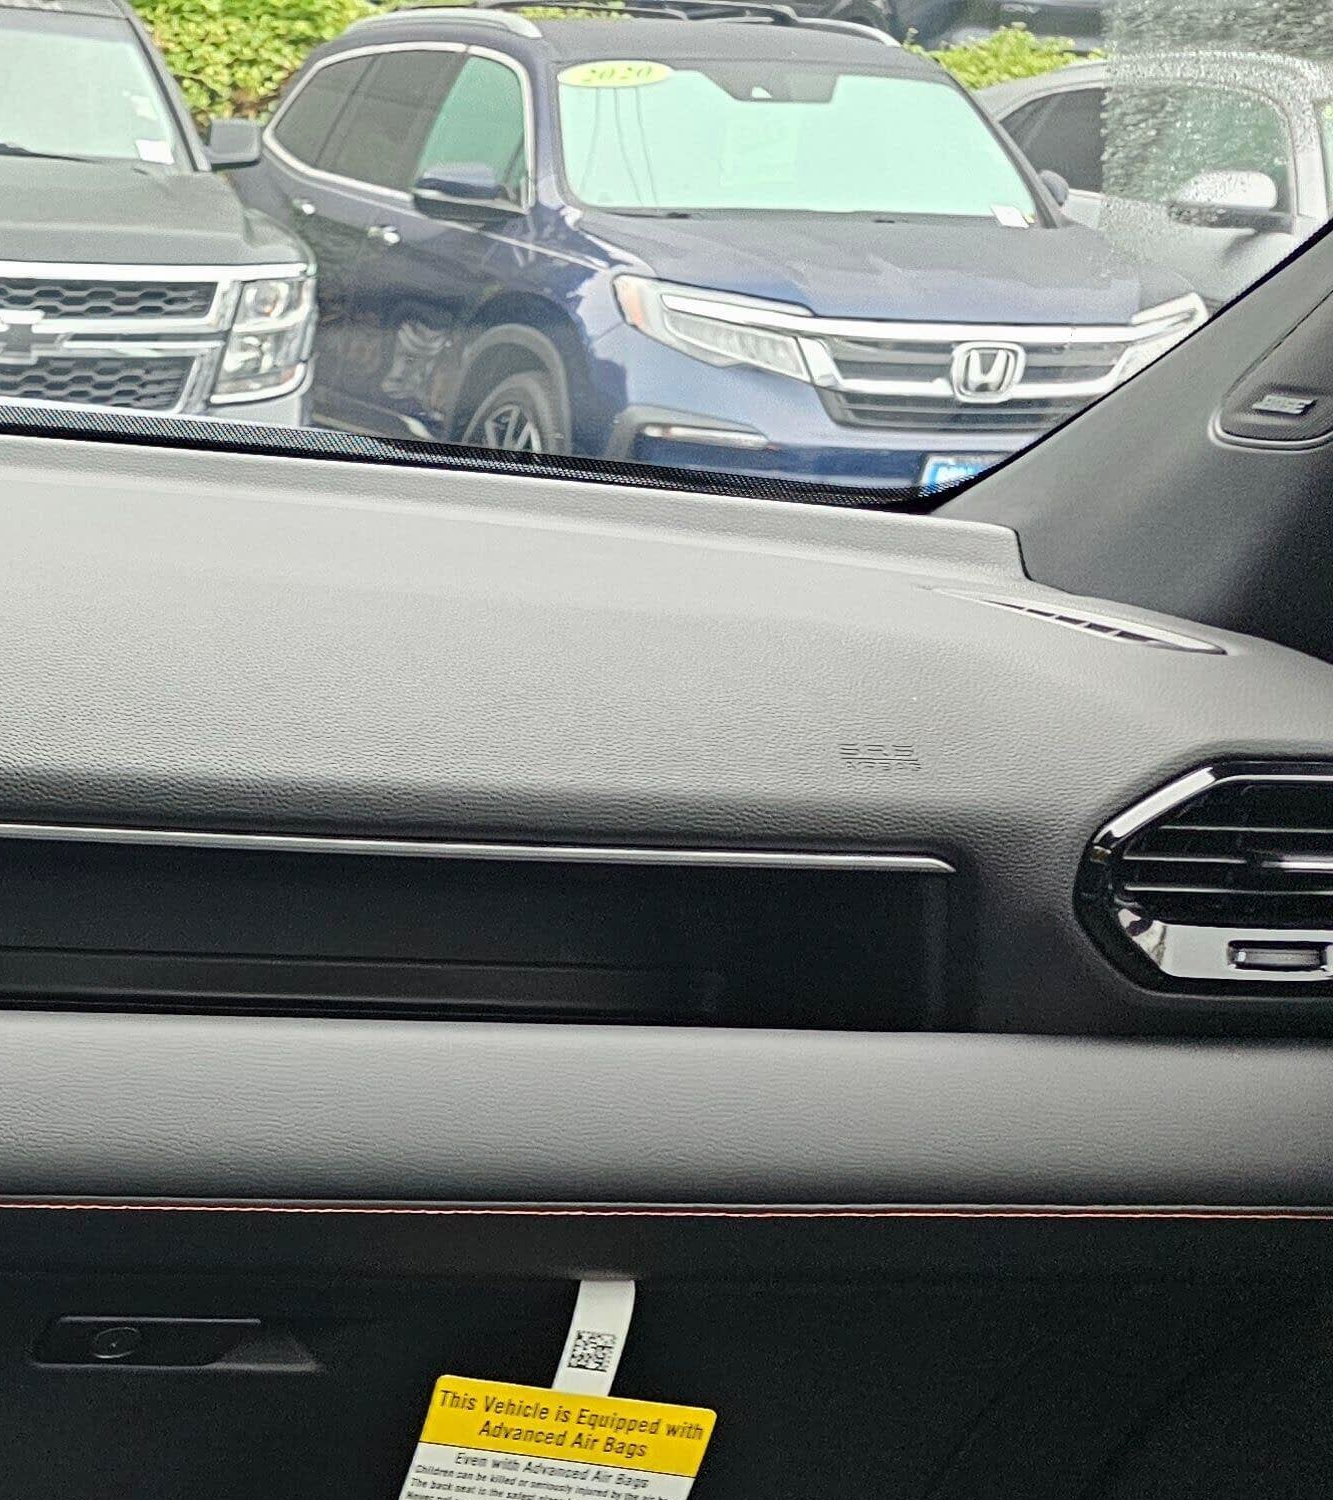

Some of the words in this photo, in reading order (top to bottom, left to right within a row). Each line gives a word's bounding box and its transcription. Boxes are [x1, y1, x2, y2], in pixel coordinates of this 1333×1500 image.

[582, 65, 653, 83] 2020
[839, 743, 914, 757] SRS
[439, 1389, 478, 1411] This
[483, 1395, 550, 1421] Vehicle
[554, 1406, 571, 1423] is
[576, 1408, 662, 1435] Equipped
[665, 1421, 704, 1440] with
[478, 1420, 568, 1447] Advanced
[570, 1432, 599, 1451] Air
[603, 1436, 649, 1459] Bags
[410, 1477, 428, 1488] The
[429, 1480, 454, 1491] back
[454, 1485, 476, 1494] seat
[478, 1486, 488, 1496] is
[489, 1487, 504, 1498] the
[415, 1464, 454, 1478] Children
[455, 1471, 474, 1481] can
[475, 1469, 487, 1482] be
[490, 1474, 518, 1486] killed
[518, 1479, 529, 1487] or
[530, 1481, 572, 1495] seriously
[575, 1486, 609, 1498] injured
[611, 1490, 622, 1500] by
[454, 1452, 488, 1467] Even
[490, 1457, 521, 1472] with
[522, 1461, 590, 1480] Advanced
[591, 1470, 613, 1483] Air
[614, 1473, 650, 1489] Bags
